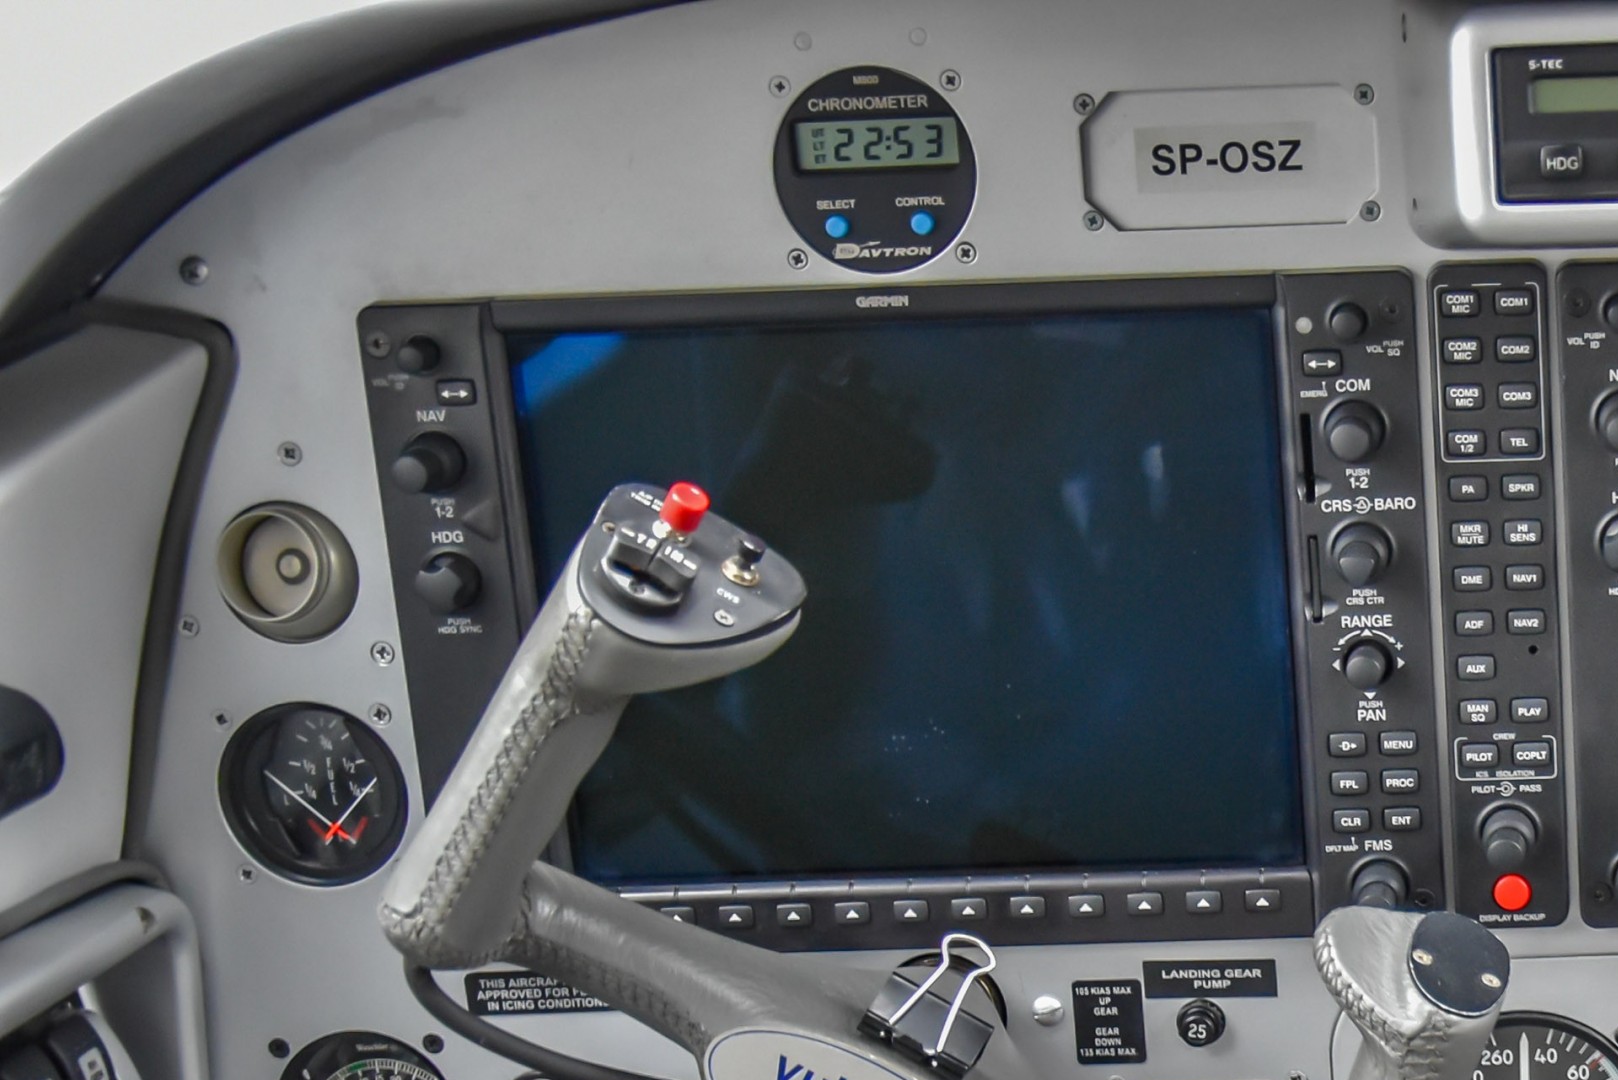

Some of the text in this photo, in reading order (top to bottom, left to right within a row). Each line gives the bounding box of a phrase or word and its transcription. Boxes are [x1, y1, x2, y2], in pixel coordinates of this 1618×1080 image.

[1528, 59, 1564, 70] S-TEC
[808, 94, 928, 112] CHRONOMETER
[834, 124, 943, 161] 22:53
[1152, 139, 1304, 176] SP-OSZ
[1545, 154, 1580, 172] HDG
[816, 199, 855, 210] SELECT
[896, 197, 945, 206] CONTROL
[834, 243, 931, 259] DAVTRON
[856, 296, 908, 307] GARMIN
[1446, 295, 1474, 304] COM1
[1500, 298, 1528, 307] COM1
[1452, 305, 1470, 313] MIC
[1448, 342, 1476, 351] COM2
[1501, 345, 1530, 354] COM2
[1454, 351, 1472, 360] MIC
[1335, 379, 1370, 392] COM
[1450, 388, 1478, 397] COM3
[1503, 391, 1531, 400] COM3
[1456, 398, 1474, 407] MIC
[417, 410, 446, 422] NAV
[1455, 435, 1478, 444] COM
[1510, 438, 1528, 447] TEL
[1461, 444, 1474, 453] 1/2
[1349, 477, 1369, 489] 1-2
[1509, 483, 1534, 492] SPKR
[1462, 485, 1475, 494] PA
[1321, 497, 1416, 512] CRS BARO
[435, 506, 454, 518] 1-2
[1460, 524, 1481, 533] MKR
[1518, 524, 1528, 532] HI
[431, 531, 463, 543] HDG
[1457, 535, 1484, 545] MUTE
[1510, 532, 1536, 541] SENS
[1461, 575, 1482, 584] DME
[1513, 574, 1537, 582] NAV1
[1341, 615, 1393, 628] RANGE
[1465, 621, 1484, 629] ADF
[1514, 619, 1539, 627] NAV2
[1466, 665, 1486, 673] AUX
[1467, 704, 1488, 713] MAN
[1518, 707, 1541, 716] PLAY
[1357, 709, 1387, 721] PAN
[1471, 713, 1485, 722] SQ
[1384, 740, 1413, 749] MENU
[1466, 753, 1493, 762] PILOT
[1516, 751, 1547, 761] COPLT
[1340, 780, 1358, 789] FPL
[1386, 778, 1414, 787] PROC
[1472, 784, 1542, 794] PILOT PASS
[1341, 817, 1361, 826] CLR
[1391, 816, 1411, 826] ENT
[1365, 840, 1392, 851] FMS
[1479, 913, 1545, 922] DISPLAY BACKUP
[1162, 968, 1262, 979] LANDING GEAR
[479, 979, 505, 989] THIS
[1194, 980, 1231, 989] PUMP
[477, 988, 542, 1000] APPROVED
[545, 988, 570, 997] FOR
[1090, 987, 1111, 995] KIAS
[487, 1001, 499, 1011] IN
[502, 1000, 535, 1011] ICING
[1099, 997, 1111, 1005] UP
[1094, 1007, 1118, 1015] GEAR
[1095, 1028, 1120, 1036] GEAR
[1188, 1023, 1207, 1038] 25
[1095, 1038, 1121, 1046] DOWN
[1096, 1048, 1116, 1056] KIAS
[1118, 1047, 1136, 1056] MAX
[1481, 1049, 1513, 1065] 260
[1534, 1049, 1557, 1064] 40
[1567, 1065, 1590, 1080] 60
